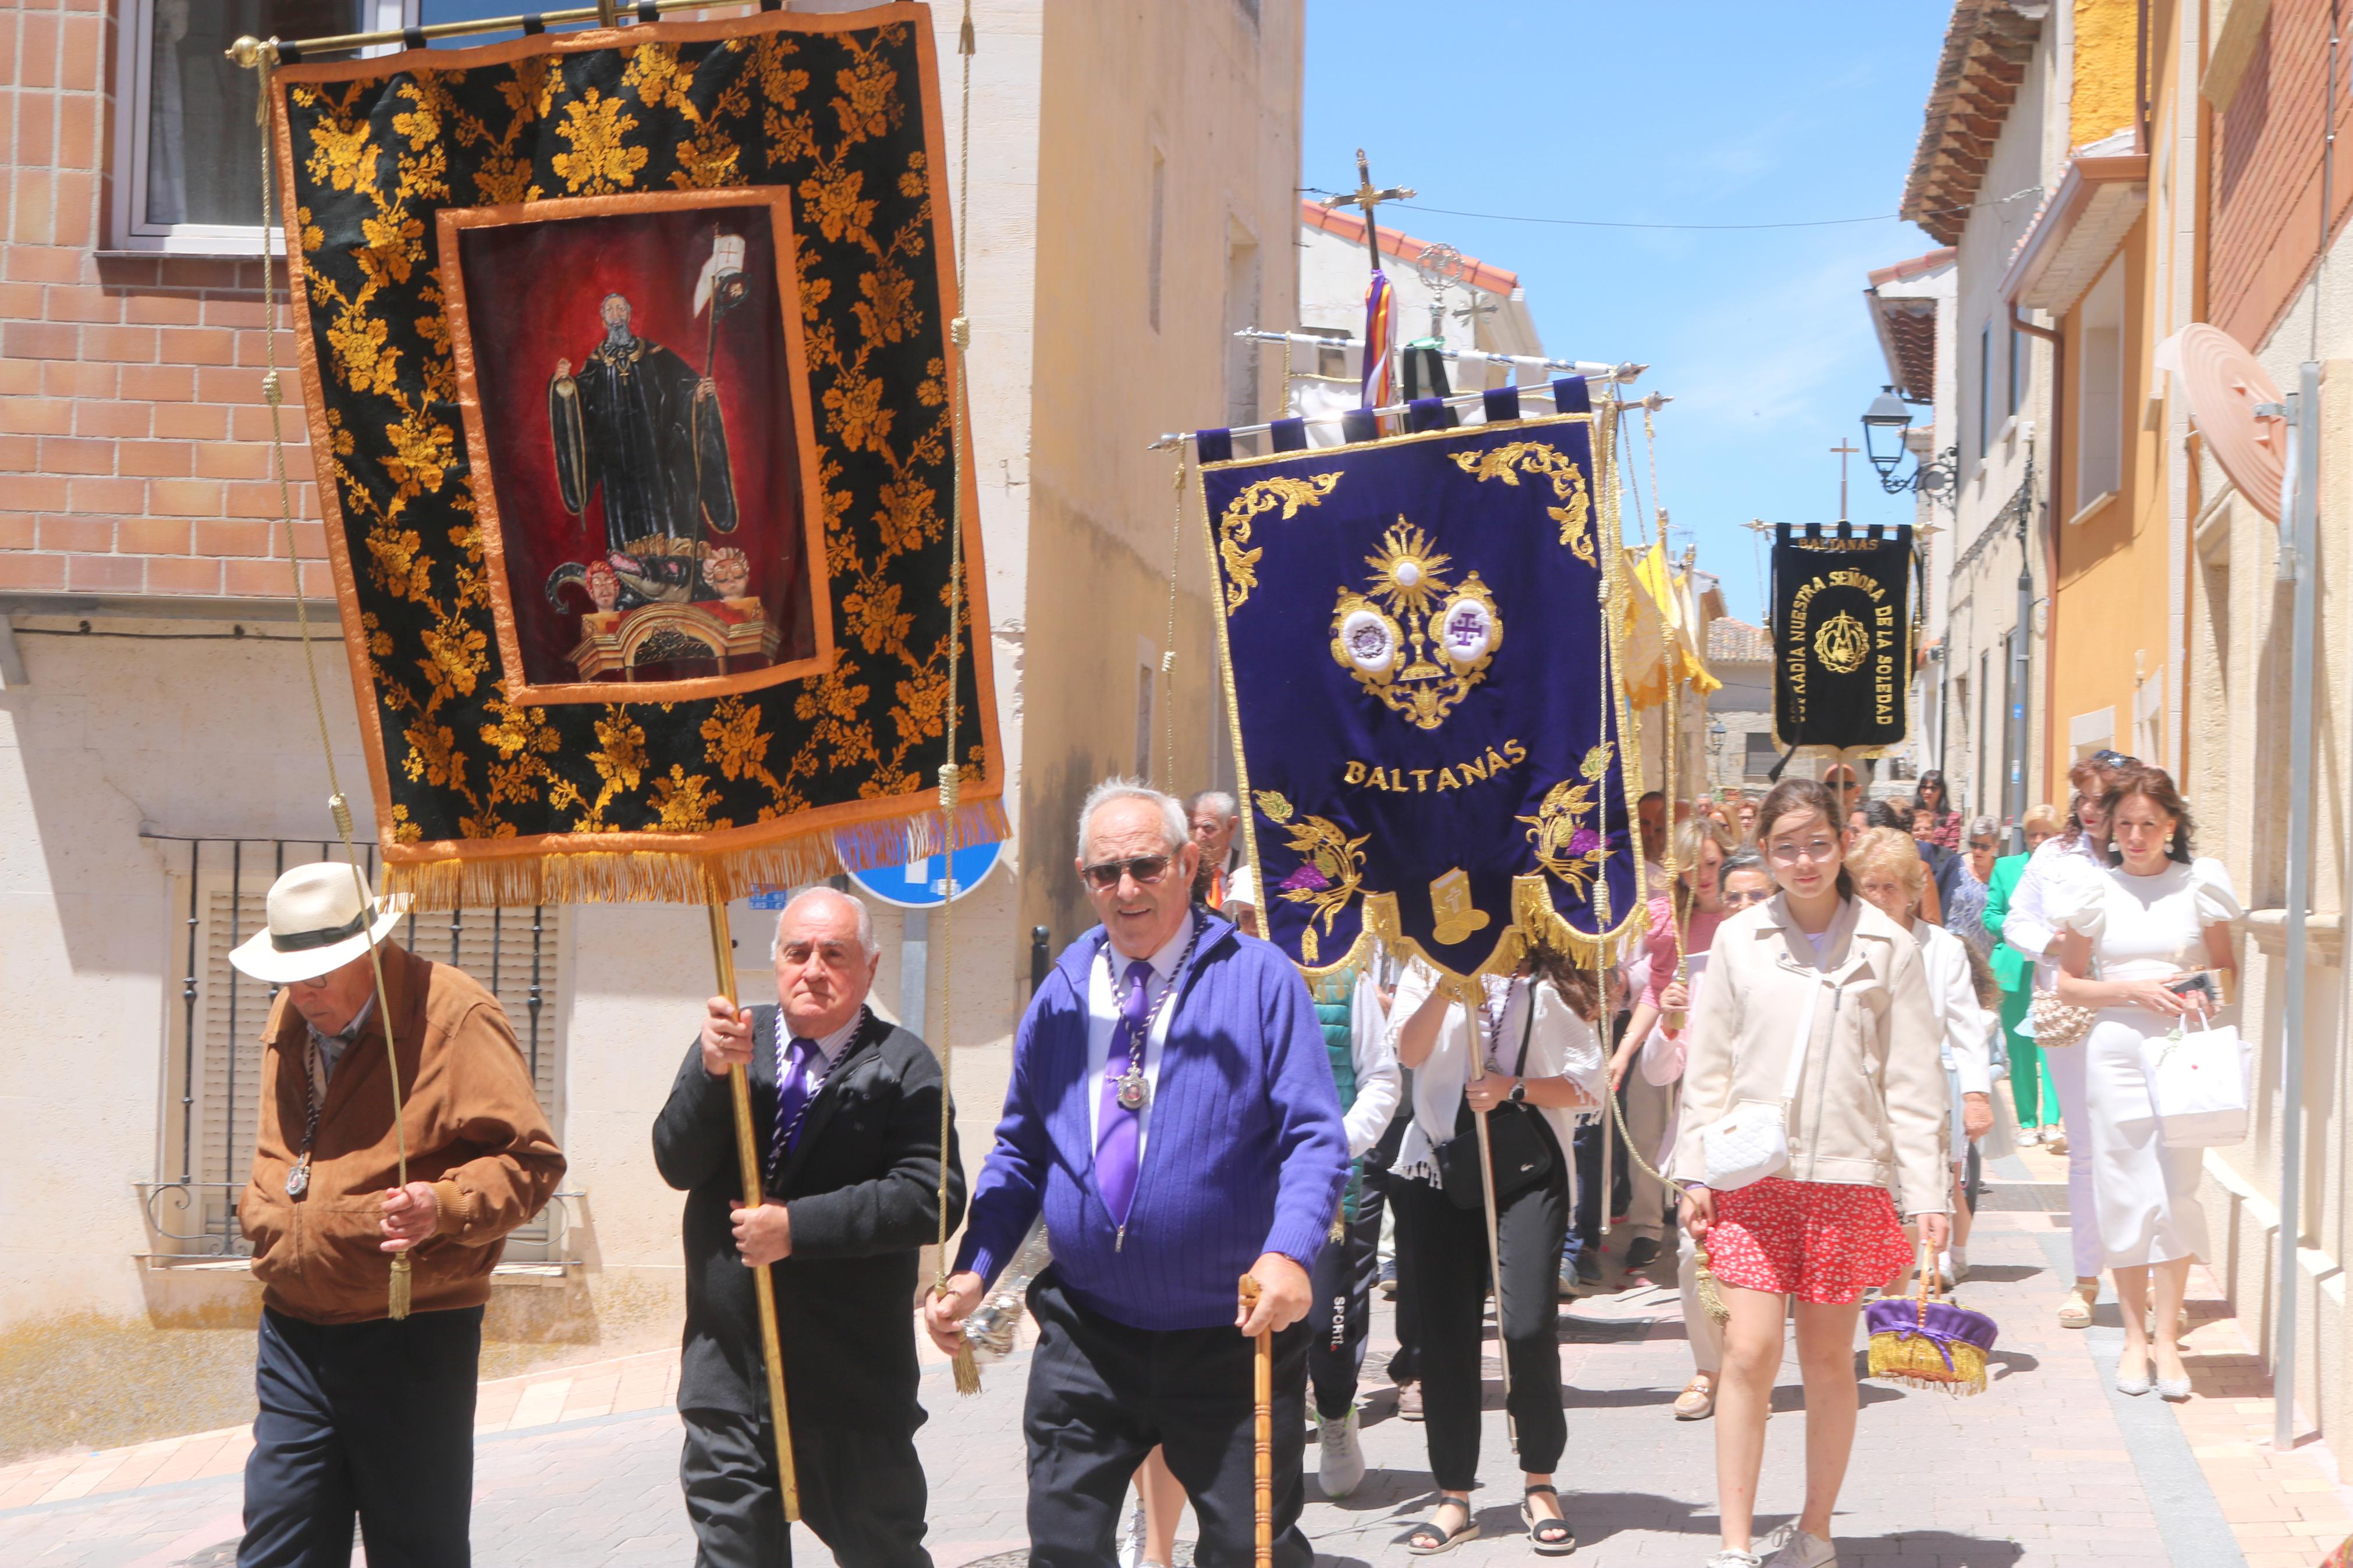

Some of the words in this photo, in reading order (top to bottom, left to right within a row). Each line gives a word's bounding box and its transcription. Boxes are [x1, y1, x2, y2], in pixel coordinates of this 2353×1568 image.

[1829, 567, 1886, 603] SEÑORA
[1789, 576, 1827, 642] NUESTRA
[1875, 605, 1893, 627] DE
[1876, 630, 1894, 649] LA
[1875, 655, 1894, 725] SOLEDAD
[1343, 738, 1527, 793] BALTANÁS
